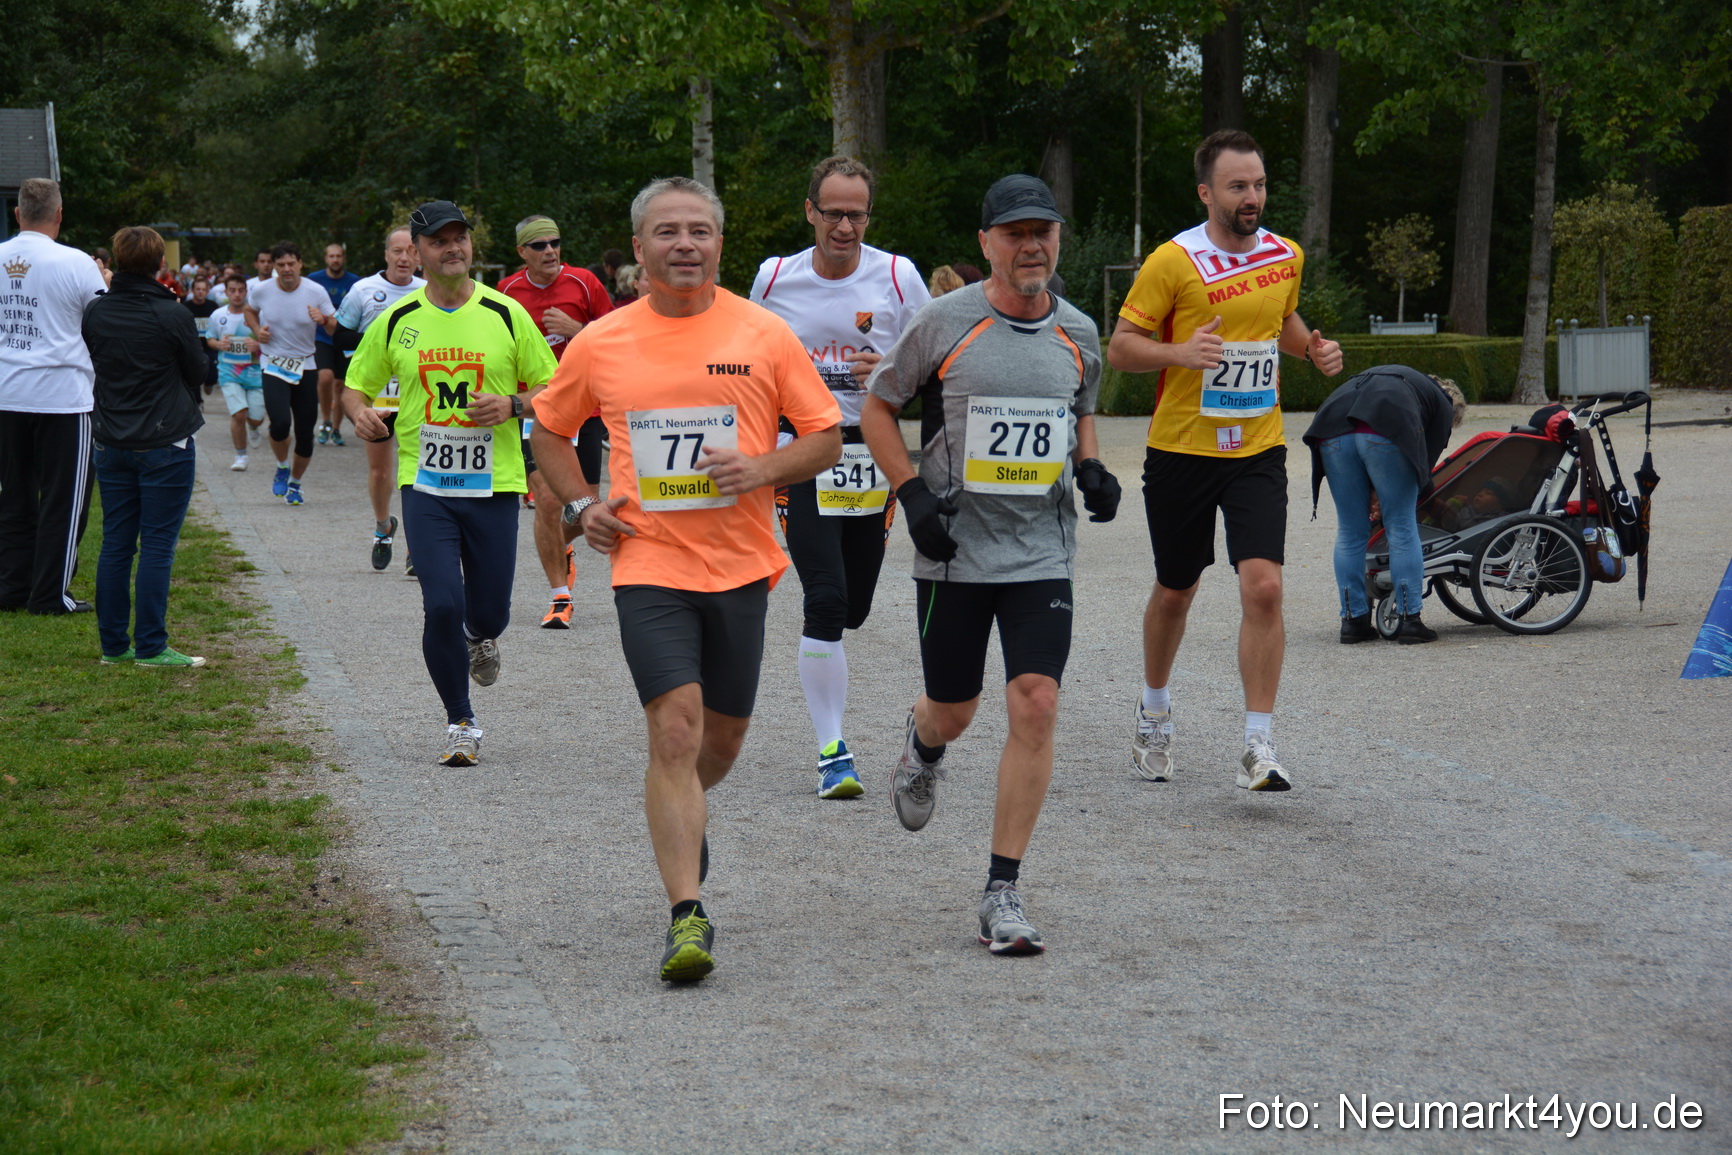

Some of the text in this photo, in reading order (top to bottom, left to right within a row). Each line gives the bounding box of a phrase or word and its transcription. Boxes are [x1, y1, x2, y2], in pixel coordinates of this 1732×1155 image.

[11, 279, 22, 290] IM
[1207, 265, 1297, 305] MAX BÖGL
[0, 294, 38, 308] AUFTRAG
[4, 309, 33, 321] SEINER
[7, 338, 32, 351] JESUS
[418, 347, 486, 363] Müller
[706, 363, 751, 377] THULE
[816, 365, 831, 374] lting
[1212, 358, 1274, 388] 2719
[436, 381, 470, 410] M
[1220, 394, 1263, 407] Christian
[970, 405, 1054, 418] PARTL Neumarkt
[630, 417, 718, 430] PARTL Neumarkt
[420, 430, 481, 442] PARTL Neumarkt
[988, 421, 1051, 458] 278
[425, 442, 486, 470] 2818
[660, 432, 704, 471] 77
[832, 463, 877, 489] 541
[996, 466, 1038, 481] Stefan
[440, 476, 465, 487] Mike
[659, 480, 710, 496] Oswald
[820, 491, 855, 503] Johann
[804, 651, 833, 659] SPORT
